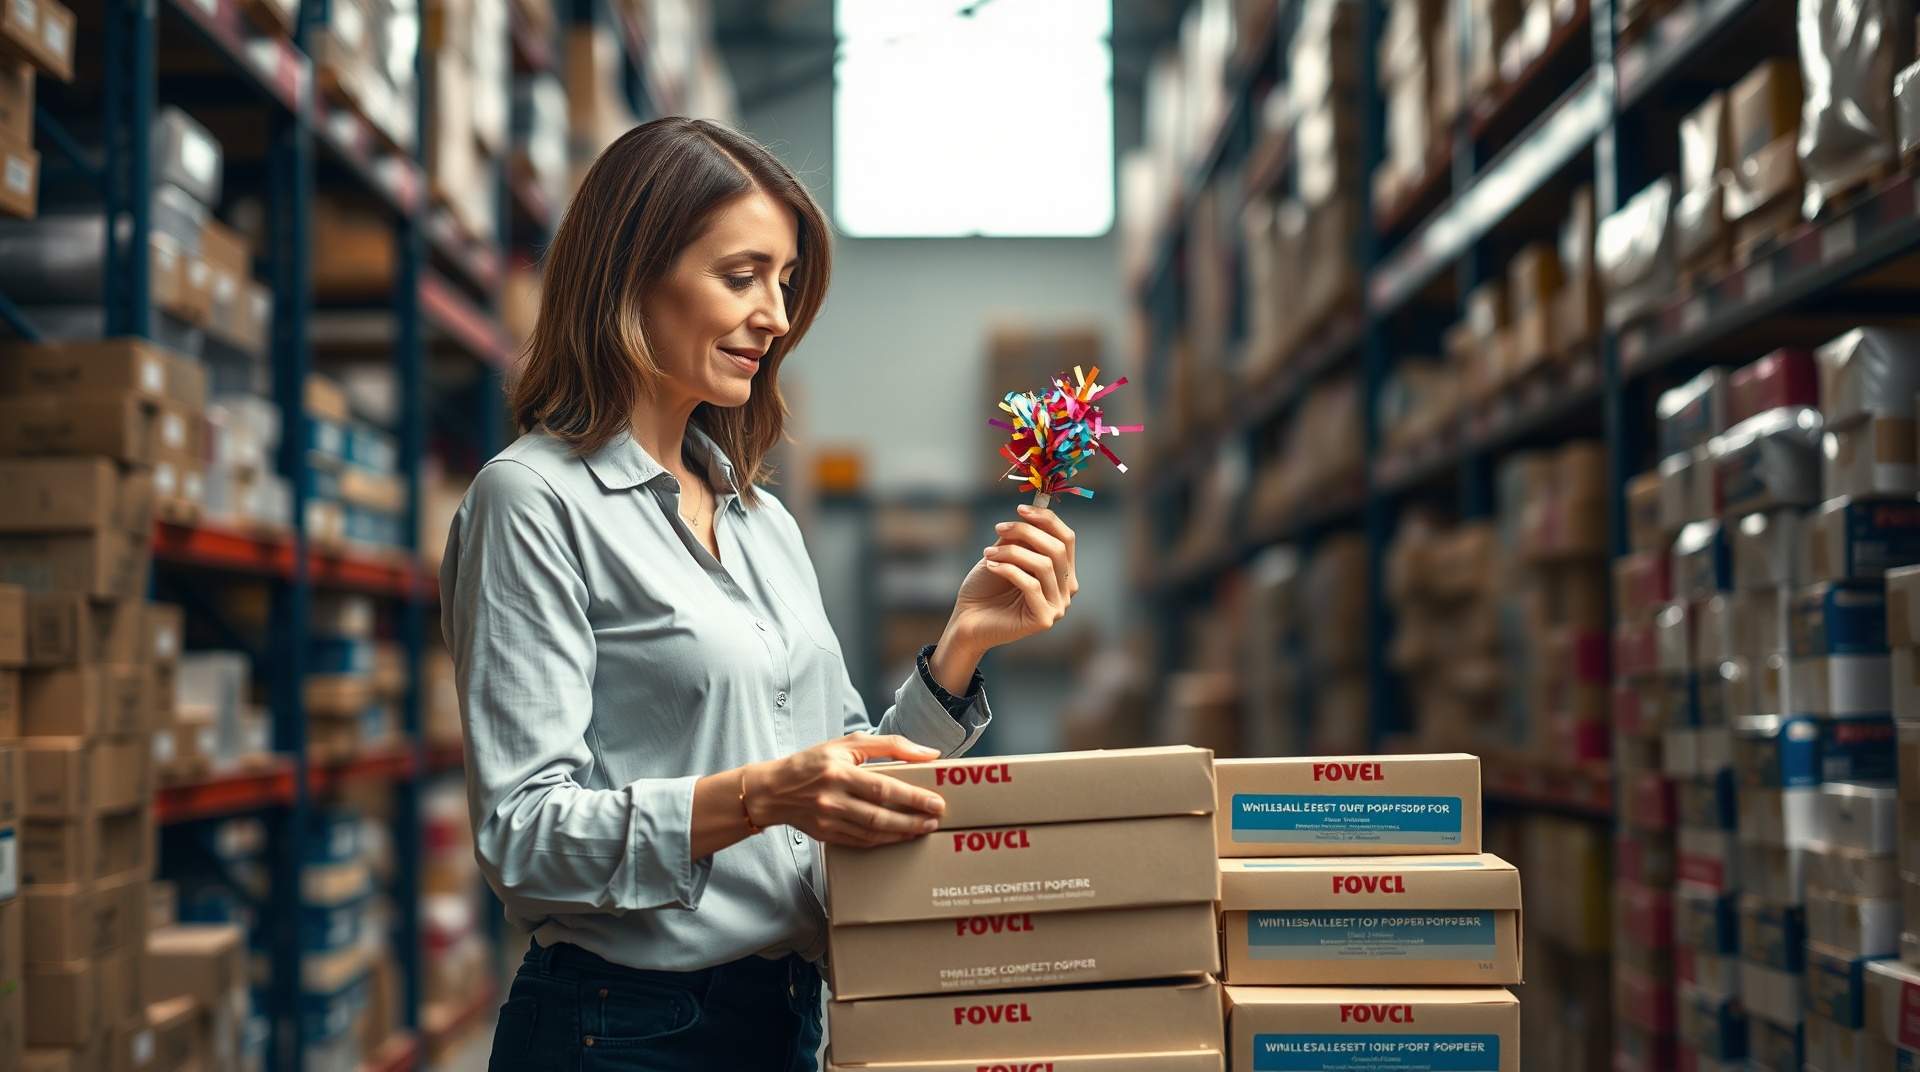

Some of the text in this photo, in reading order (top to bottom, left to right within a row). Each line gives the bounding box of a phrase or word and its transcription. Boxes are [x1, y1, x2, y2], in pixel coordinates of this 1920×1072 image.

[1313, 763, 1384, 781] FOVEL
[1428, 804, 1450, 814] FOR
[954, 1003, 1032, 1025] FOVEL
